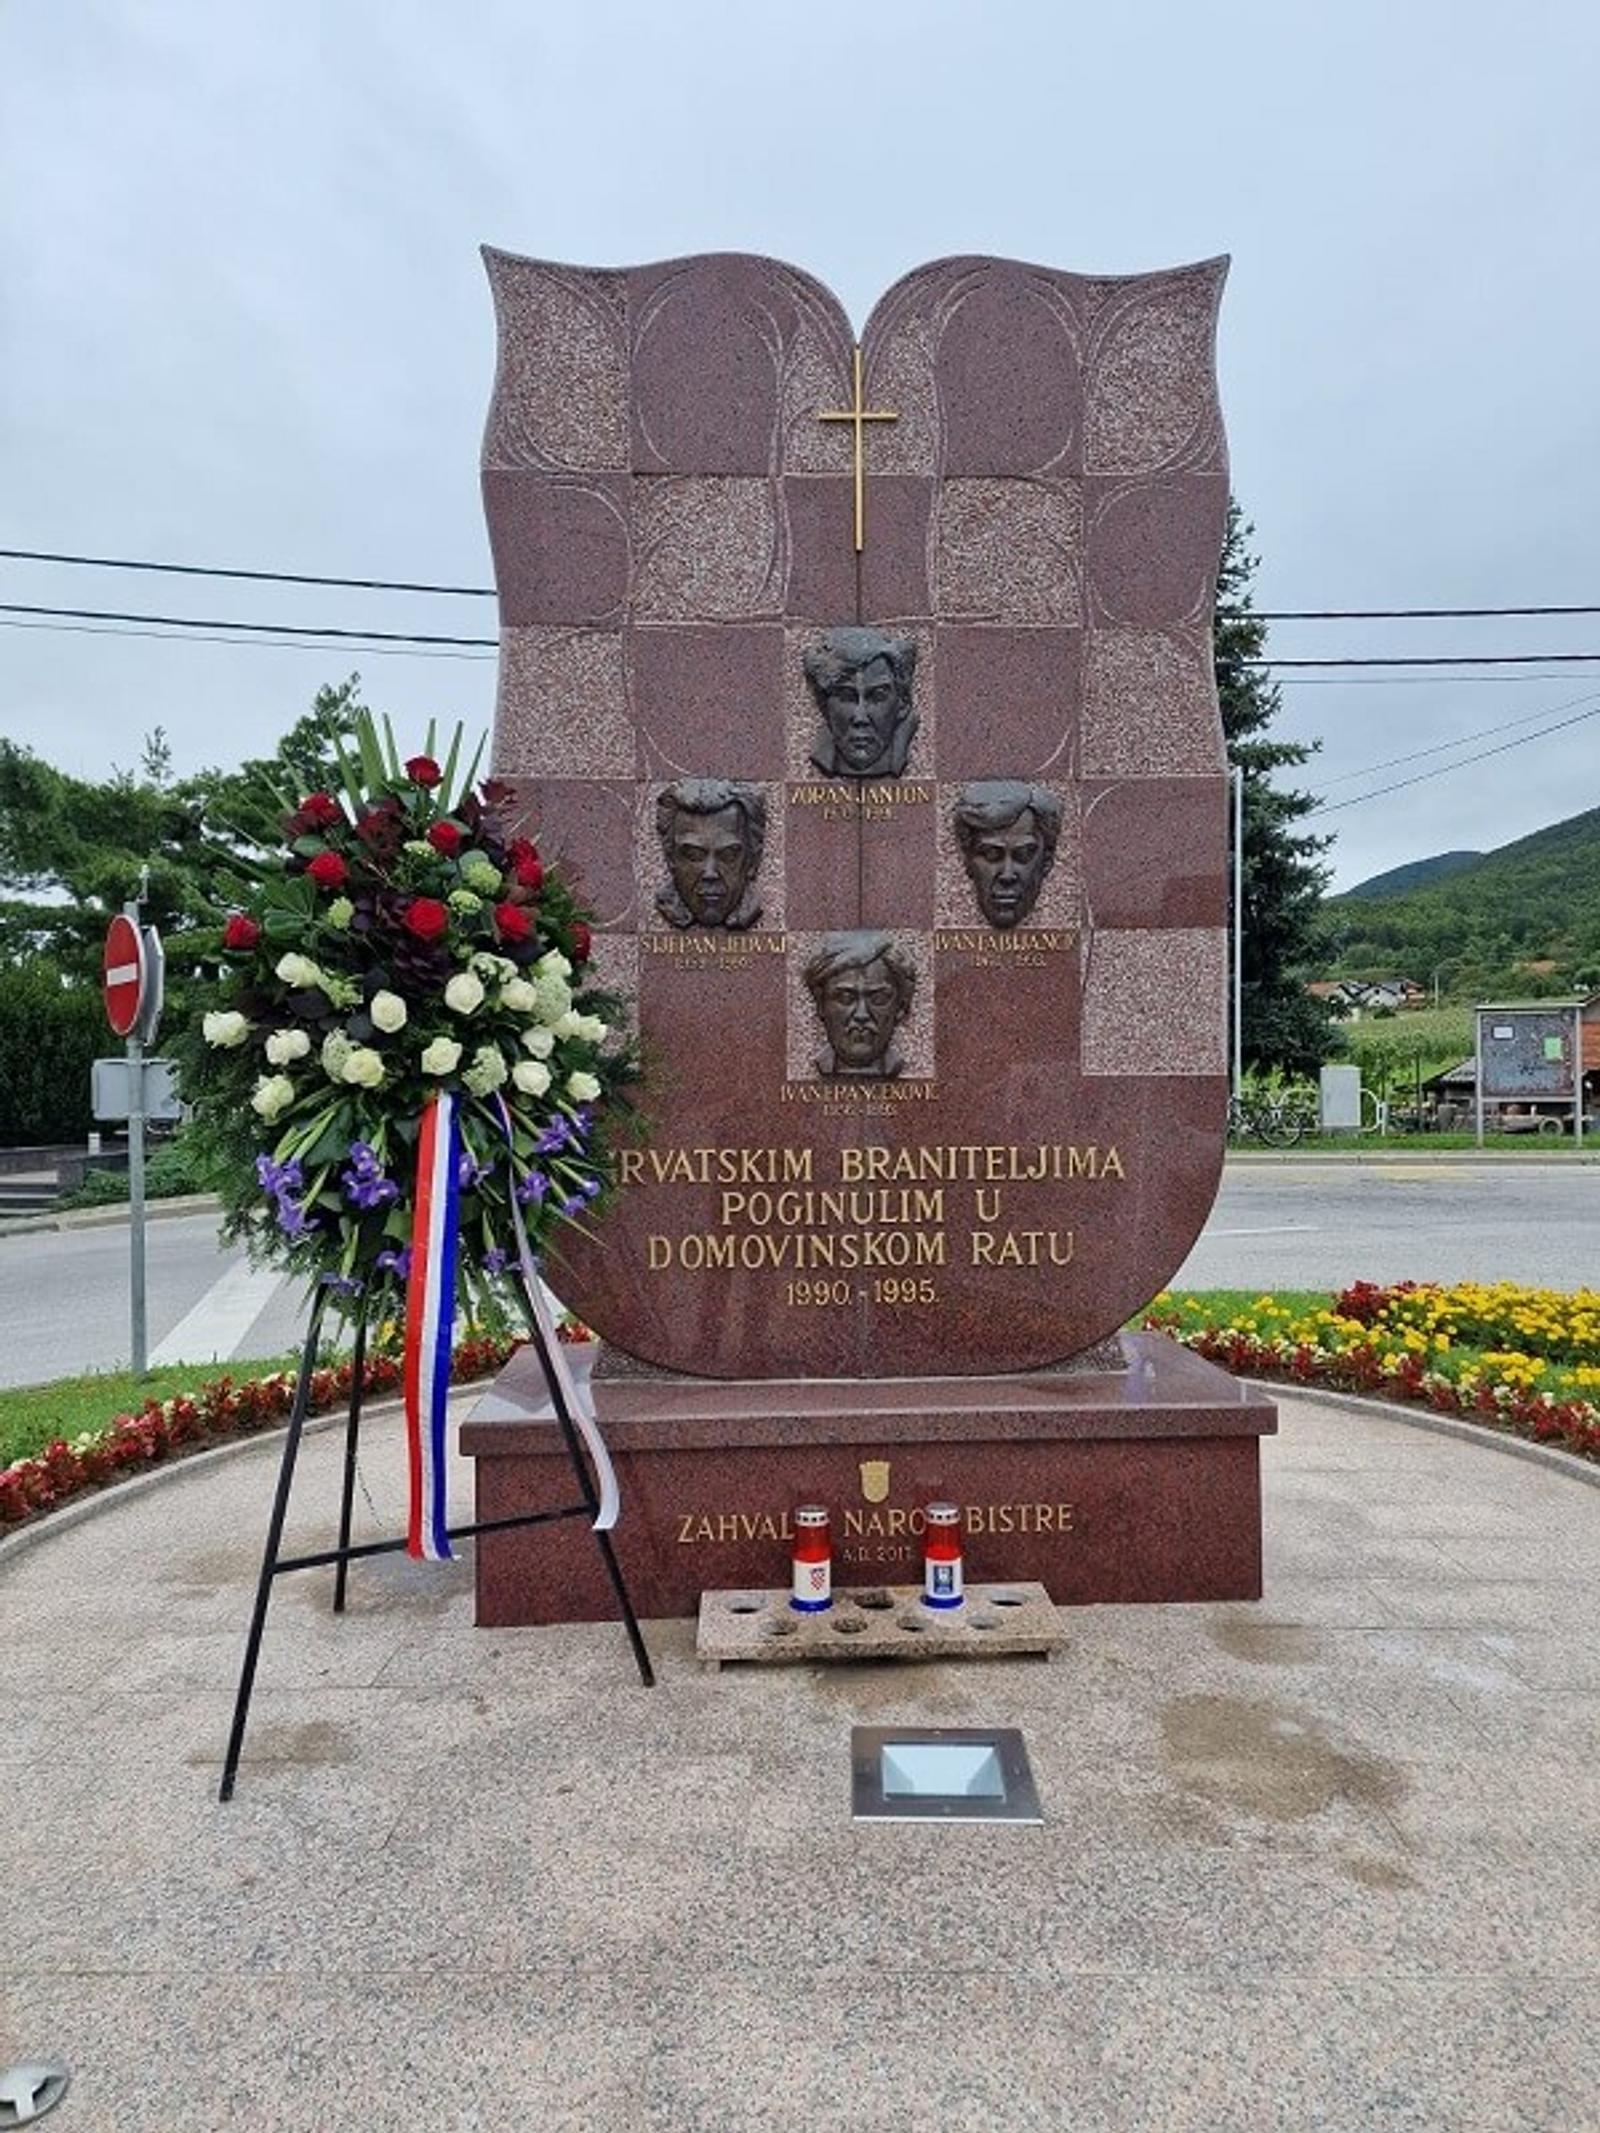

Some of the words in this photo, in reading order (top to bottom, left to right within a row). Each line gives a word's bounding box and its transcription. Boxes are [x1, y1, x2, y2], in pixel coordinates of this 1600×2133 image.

[608, 1148, 813, 1184] RVATSKIM
[841, 1146, 1124, 1182] BRANITELJIMA
[721, 1190, 943, 1226] POGINULIM
[976, 1189, 1001, 1222] U
[648, 1233, 946, 1270] DOMOVINSKOM
[971, 1231, 1074, 1265] RATU
[678, 1512, 795, 1543] ZAHVAL
[843, 1507, 927, 1538] NARO
[966, 1504, 1075, 1534] BISTRE
